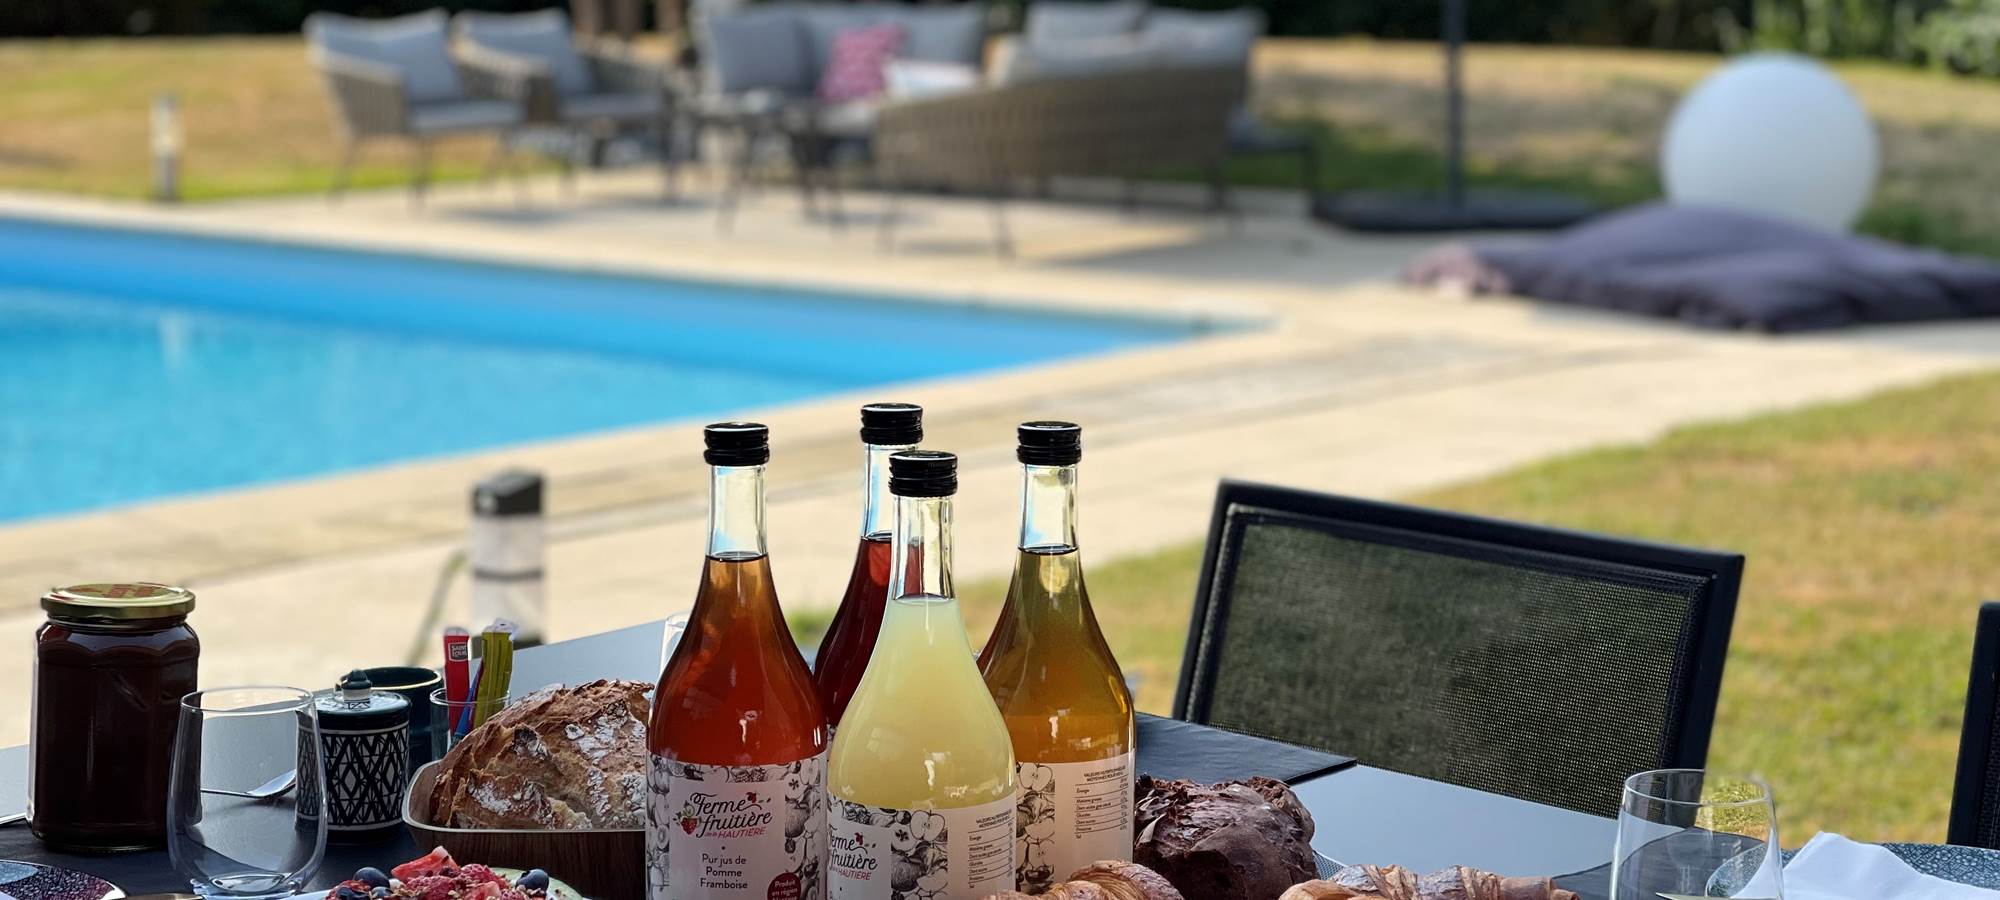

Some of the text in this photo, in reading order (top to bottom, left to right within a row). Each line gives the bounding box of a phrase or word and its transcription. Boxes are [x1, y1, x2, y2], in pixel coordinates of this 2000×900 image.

[690, 792, 762, 816] Ferme
[696, 812, 774, 838] fruitière
[702, 853, 747, 868] Pur jus de
[829, 849, 878, 871] fruitière
[706, 866, 742, 877] Pomme
[700, 878, 748, 889] Framboise
